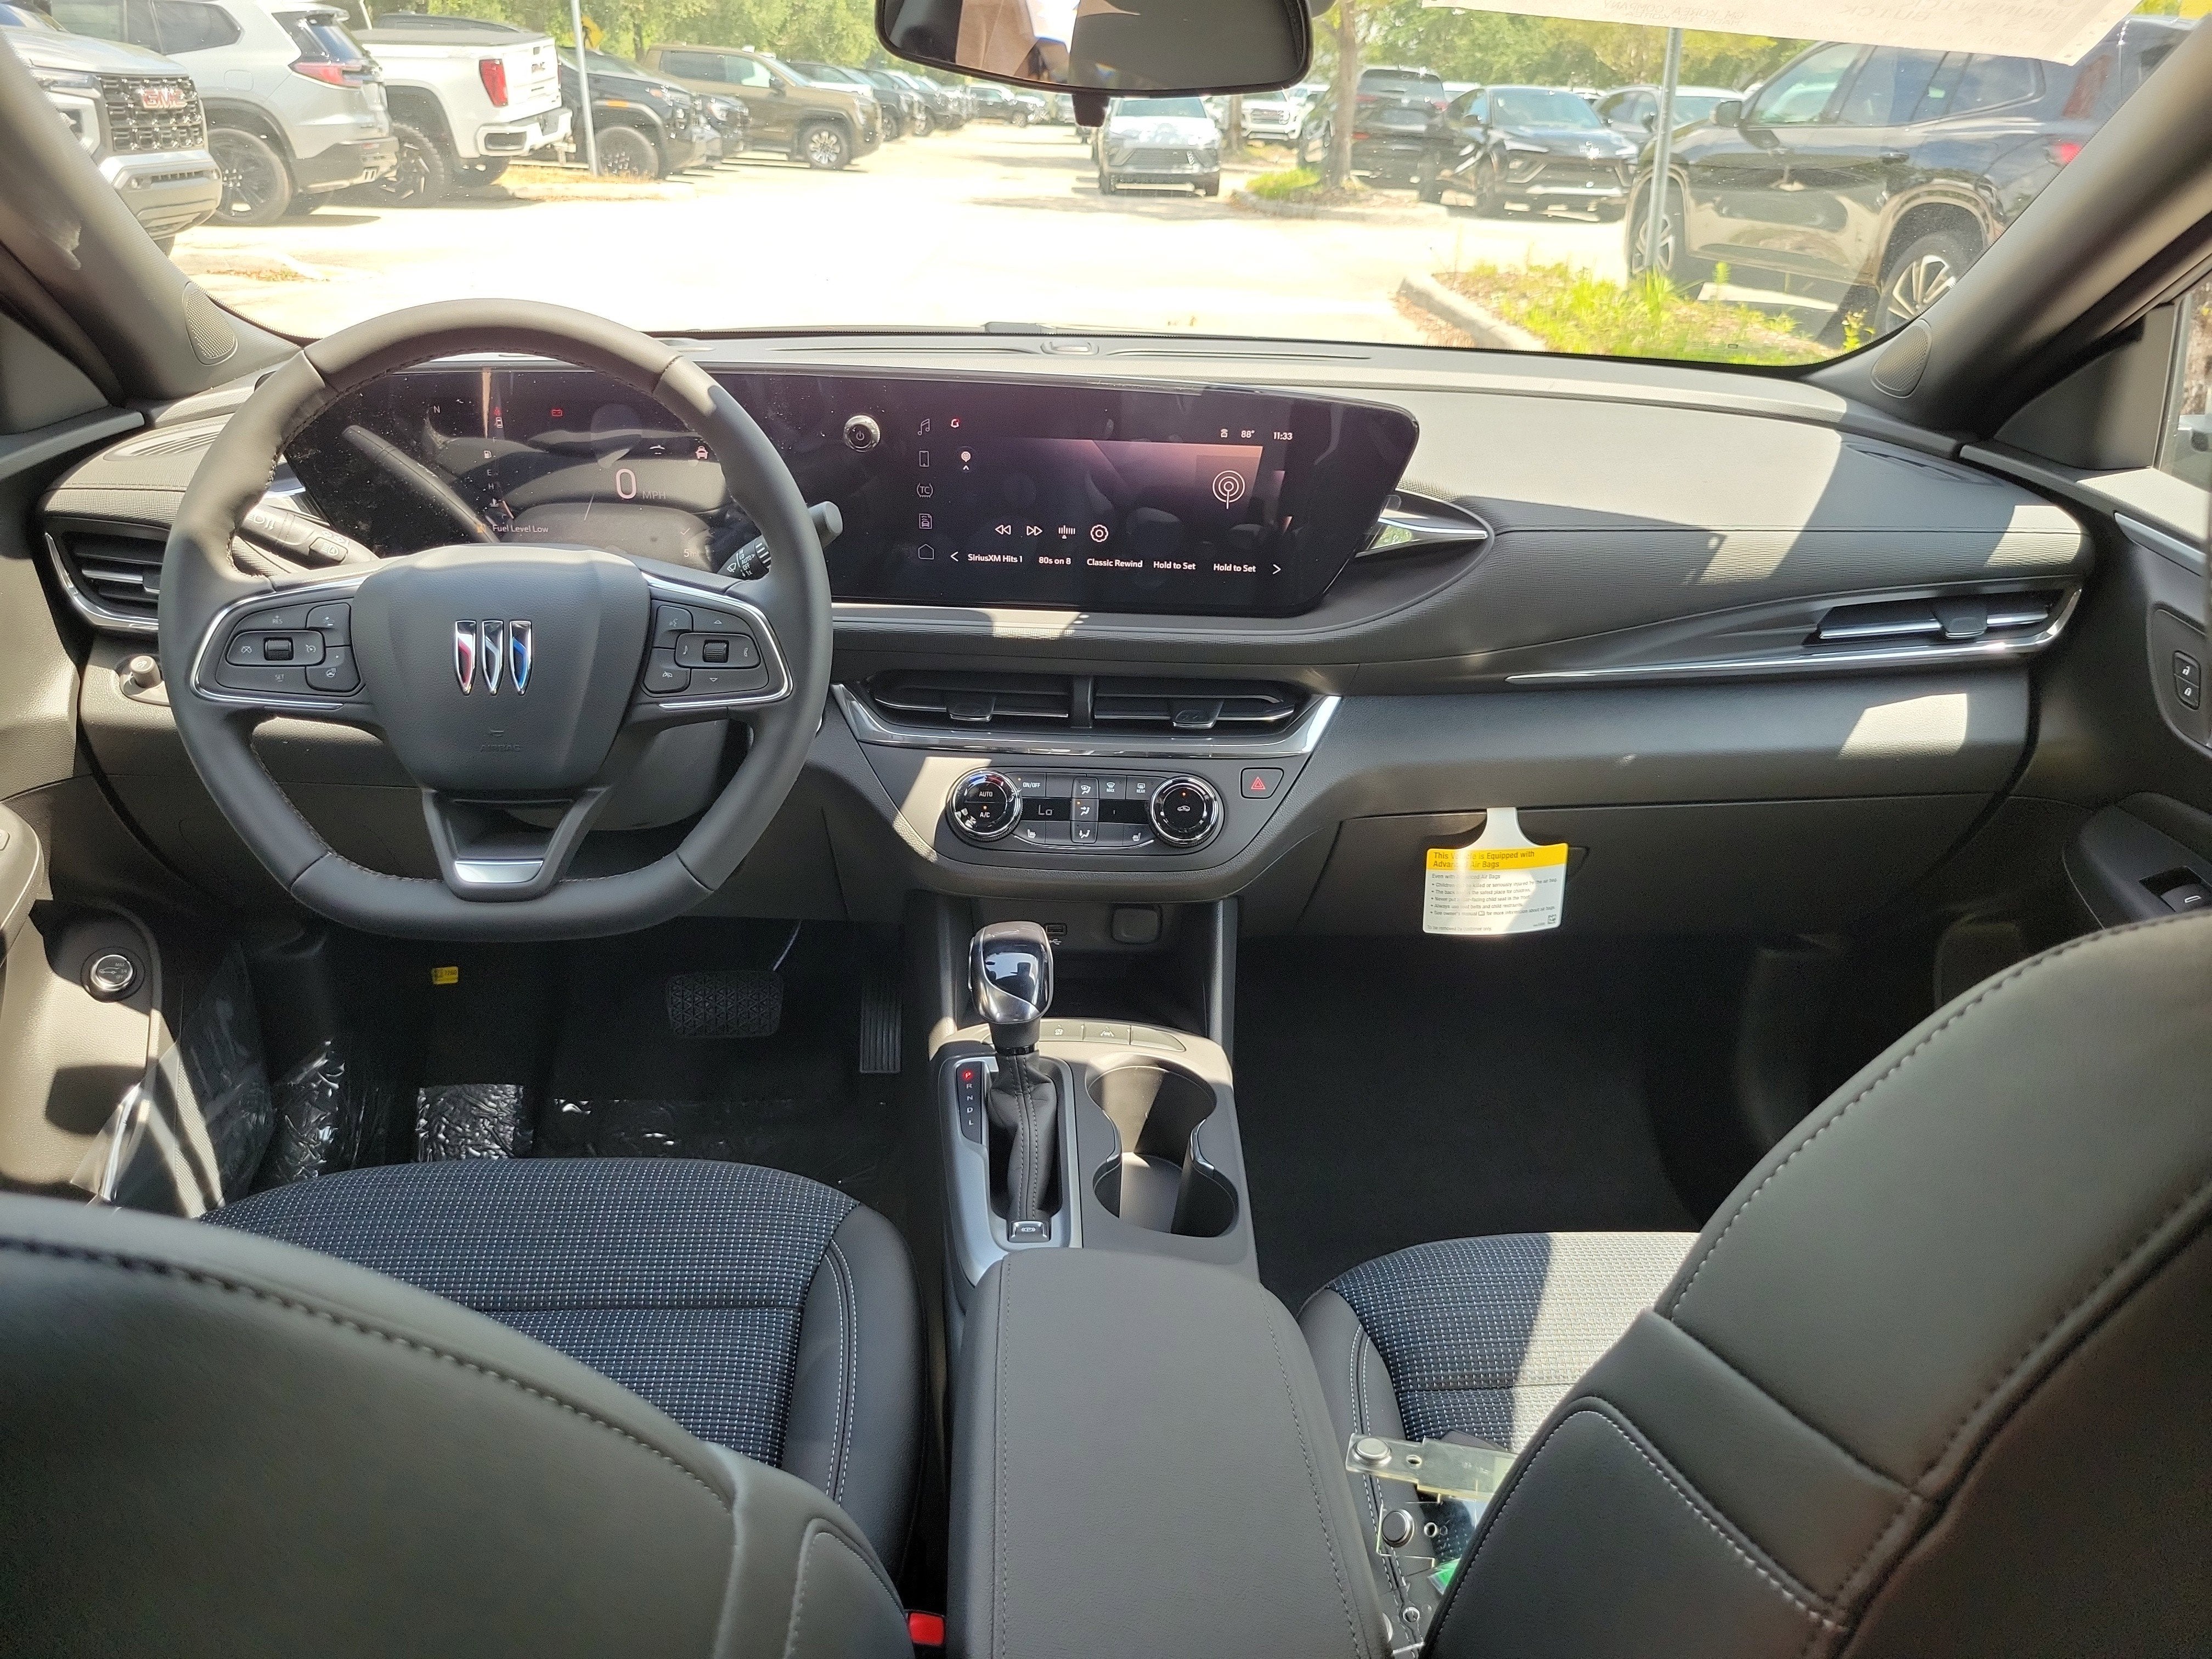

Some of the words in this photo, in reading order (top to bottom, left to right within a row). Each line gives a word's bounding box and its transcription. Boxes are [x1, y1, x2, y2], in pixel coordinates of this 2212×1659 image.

[142, 88, 187, 109] GMC
[1240, 430, 1255, 438] 88°
[1273, 432, 1293, 441] 11:33
[616, 469, 637, 499] 0
[642, 490, 666, 499] MPH
[510, 524, 531, 533] Level
[741, 555, 752, 565] AUTO
[967, 554, 1001, 562] SiriusXM
[1002, 555, 1018, 563] Hits
[1039, 556, 1053, 565] 80s
[1086, 558, 1113, 567] Classic
[1114, 560, 1143, 568] Rewind
[1213, 563, 1232, 572] Hold
[1486, 851, 1518, 861] Equipped
